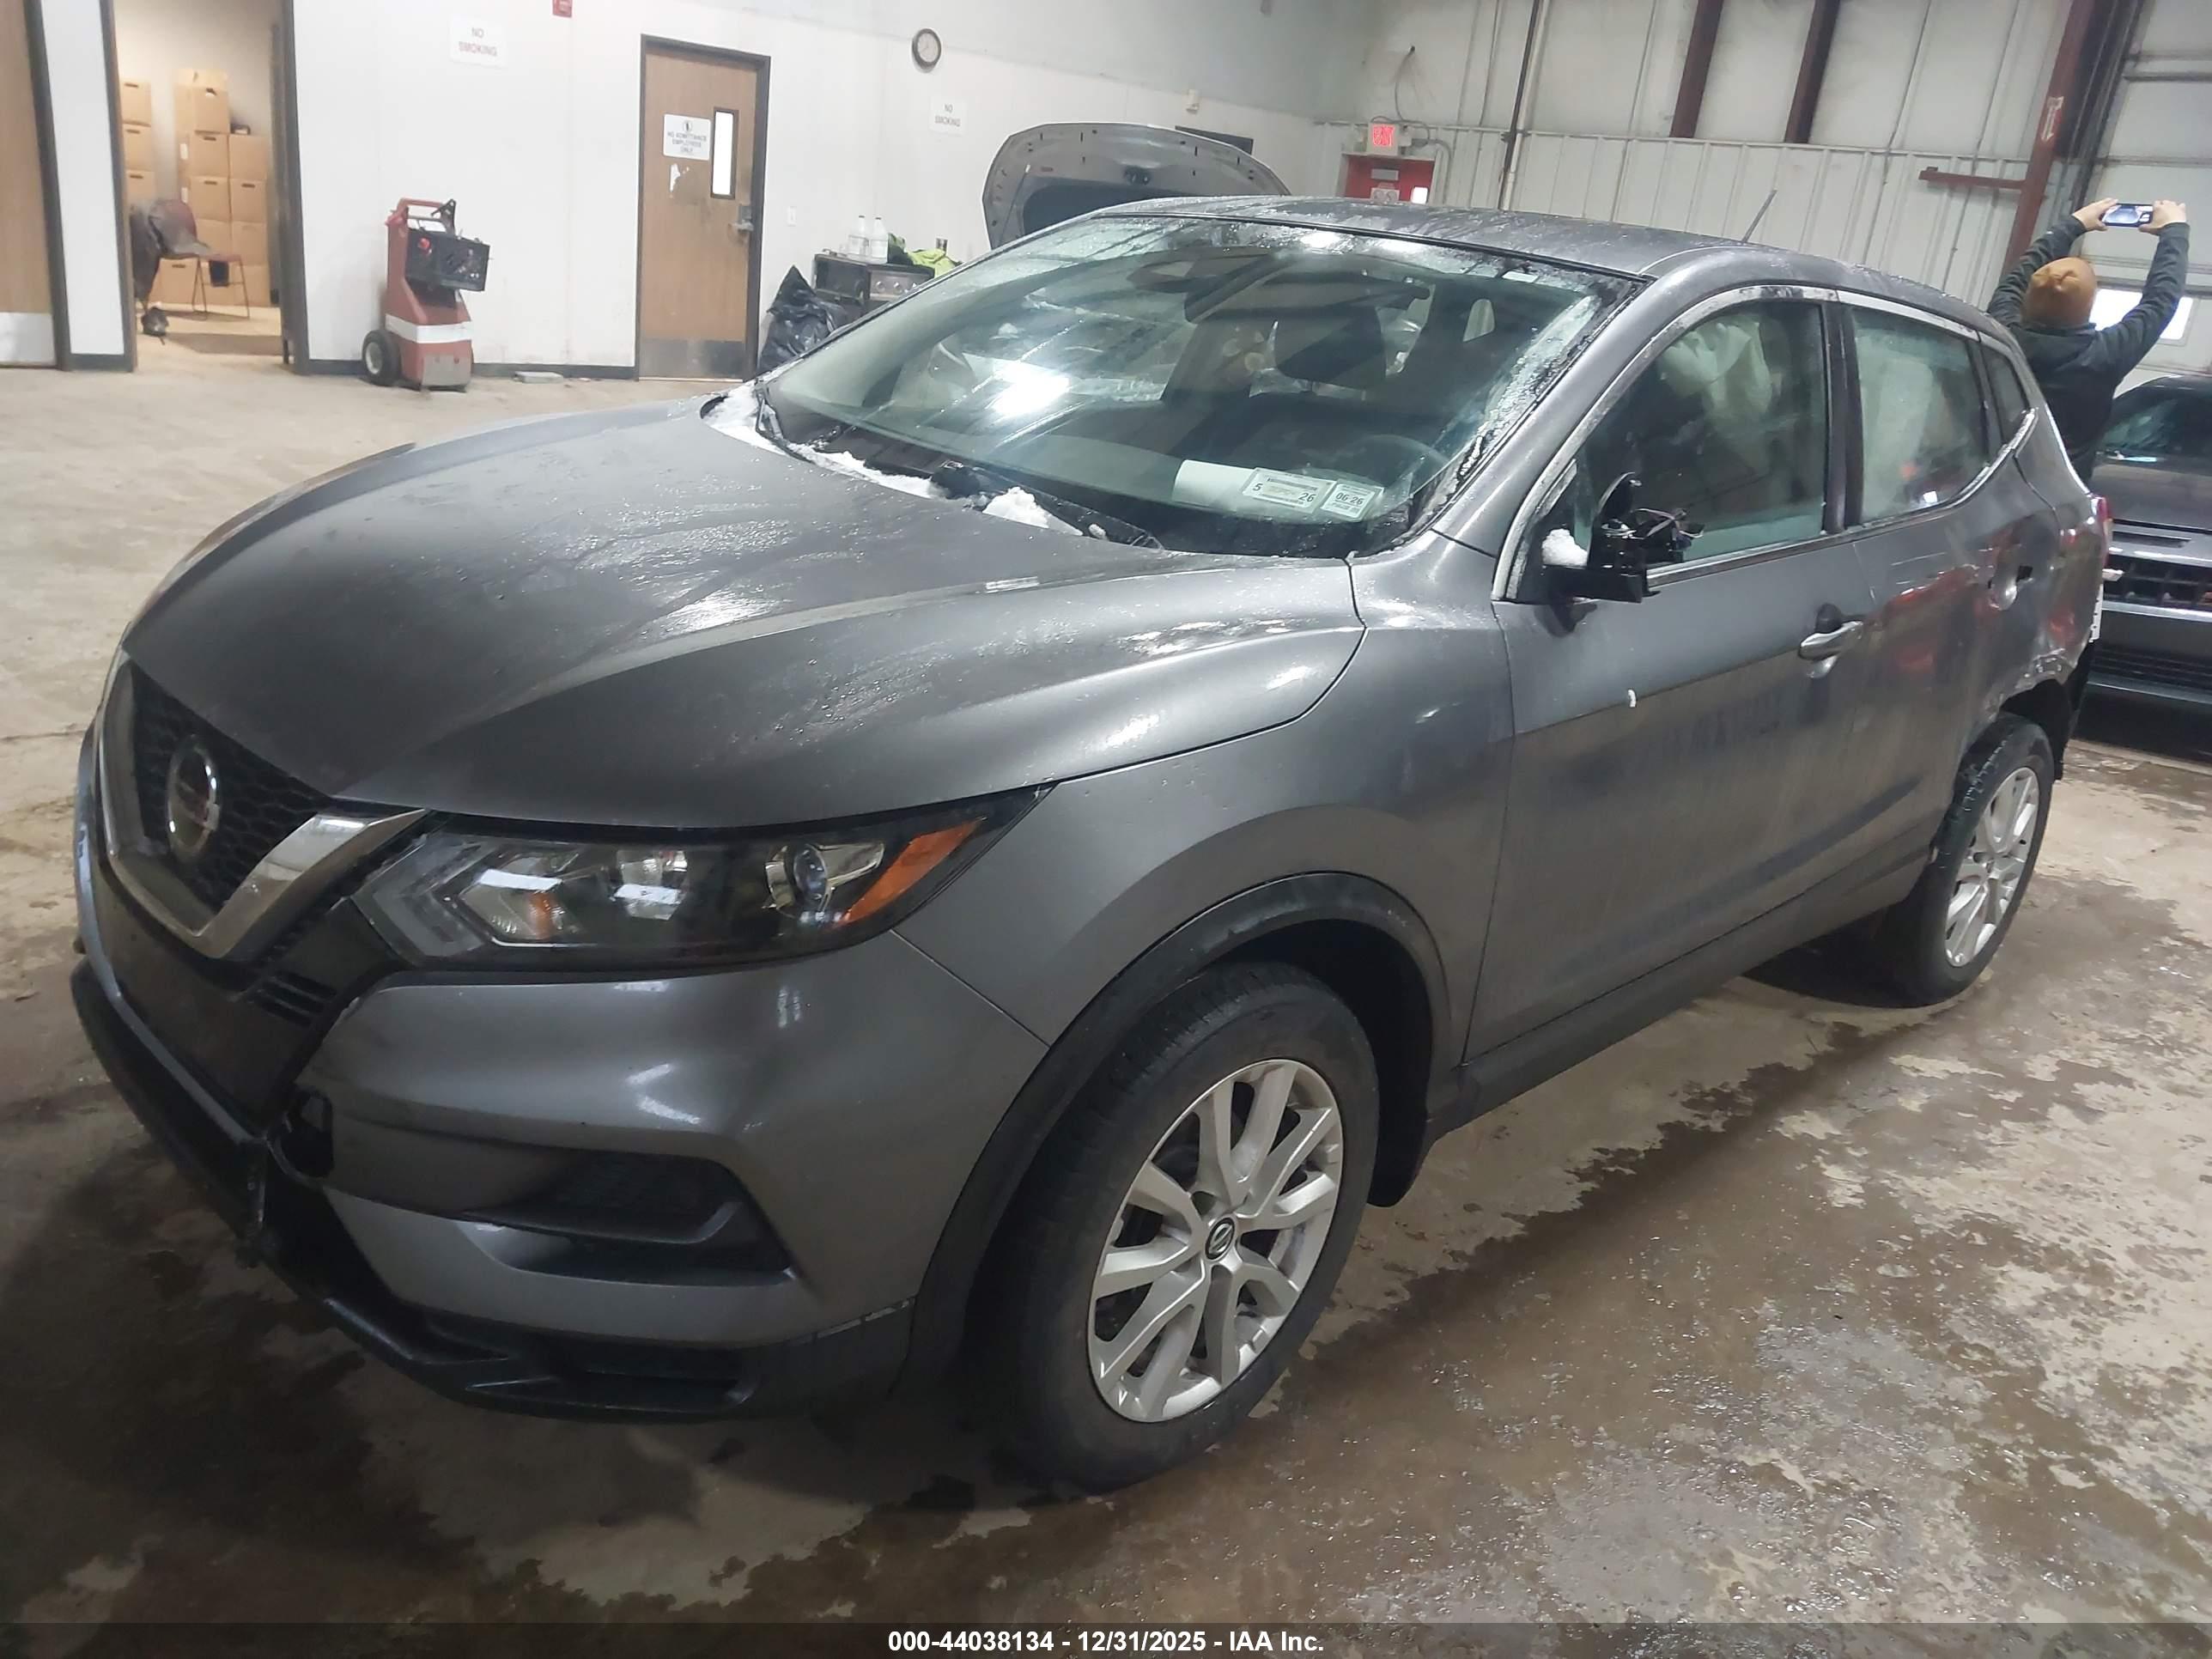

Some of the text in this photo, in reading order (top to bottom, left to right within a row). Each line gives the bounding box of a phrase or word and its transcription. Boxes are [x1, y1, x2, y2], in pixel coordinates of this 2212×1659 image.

[471, 27, 484, 38] NO
[459, 41, 497, 57] SMOKING
[945, 103, 953, 113] NO
[1252, 483, 1263, 491] 5
[1298, 492, 1316, 502] 26
